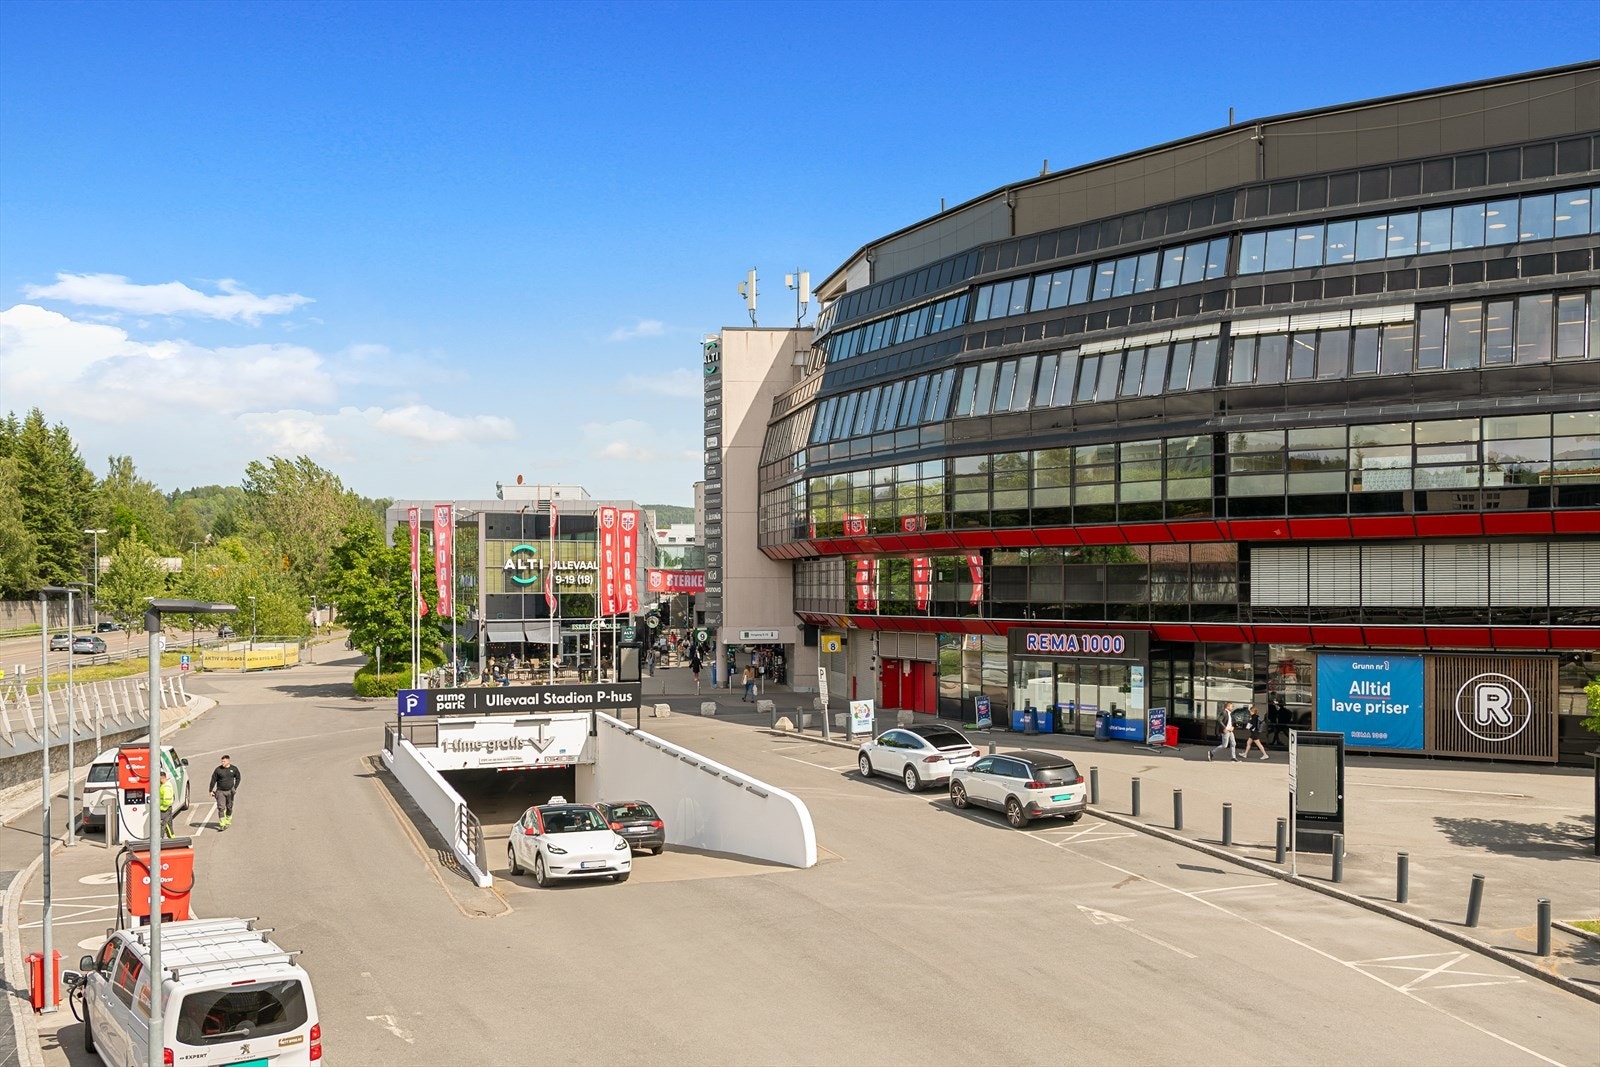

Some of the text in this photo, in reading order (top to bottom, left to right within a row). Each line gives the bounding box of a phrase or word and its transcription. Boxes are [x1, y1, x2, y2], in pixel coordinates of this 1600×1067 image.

[504, 558, 544, 570] ALTI
[555, 575, 593, 585] 9-19 (18)
[605, 533, 615, 612] NORGE
[624, 535, 633, 611] NORGE
[666, 574, 705, 587] STERKE
[1026, 633, 1125, 654] REMA 1000
[1352, 662, 1375, 670] Grunn
[1349, 680, 1391, 696] Alltid
[436, 693, 466, 702] aimo
[486, 690, 633, 707] Ullevaal Stadion P-hus
[1475, 683, 1513, 727] R
[406, 698, 418, 713] P
[436, 701, 466, 712] park
[1331, 698, 1410, 716] lave priser
[1350, 730, 1388, 740] REMA 1000
[452, 737, 482, 753] time
[486, 735, 524, 754] gratis
